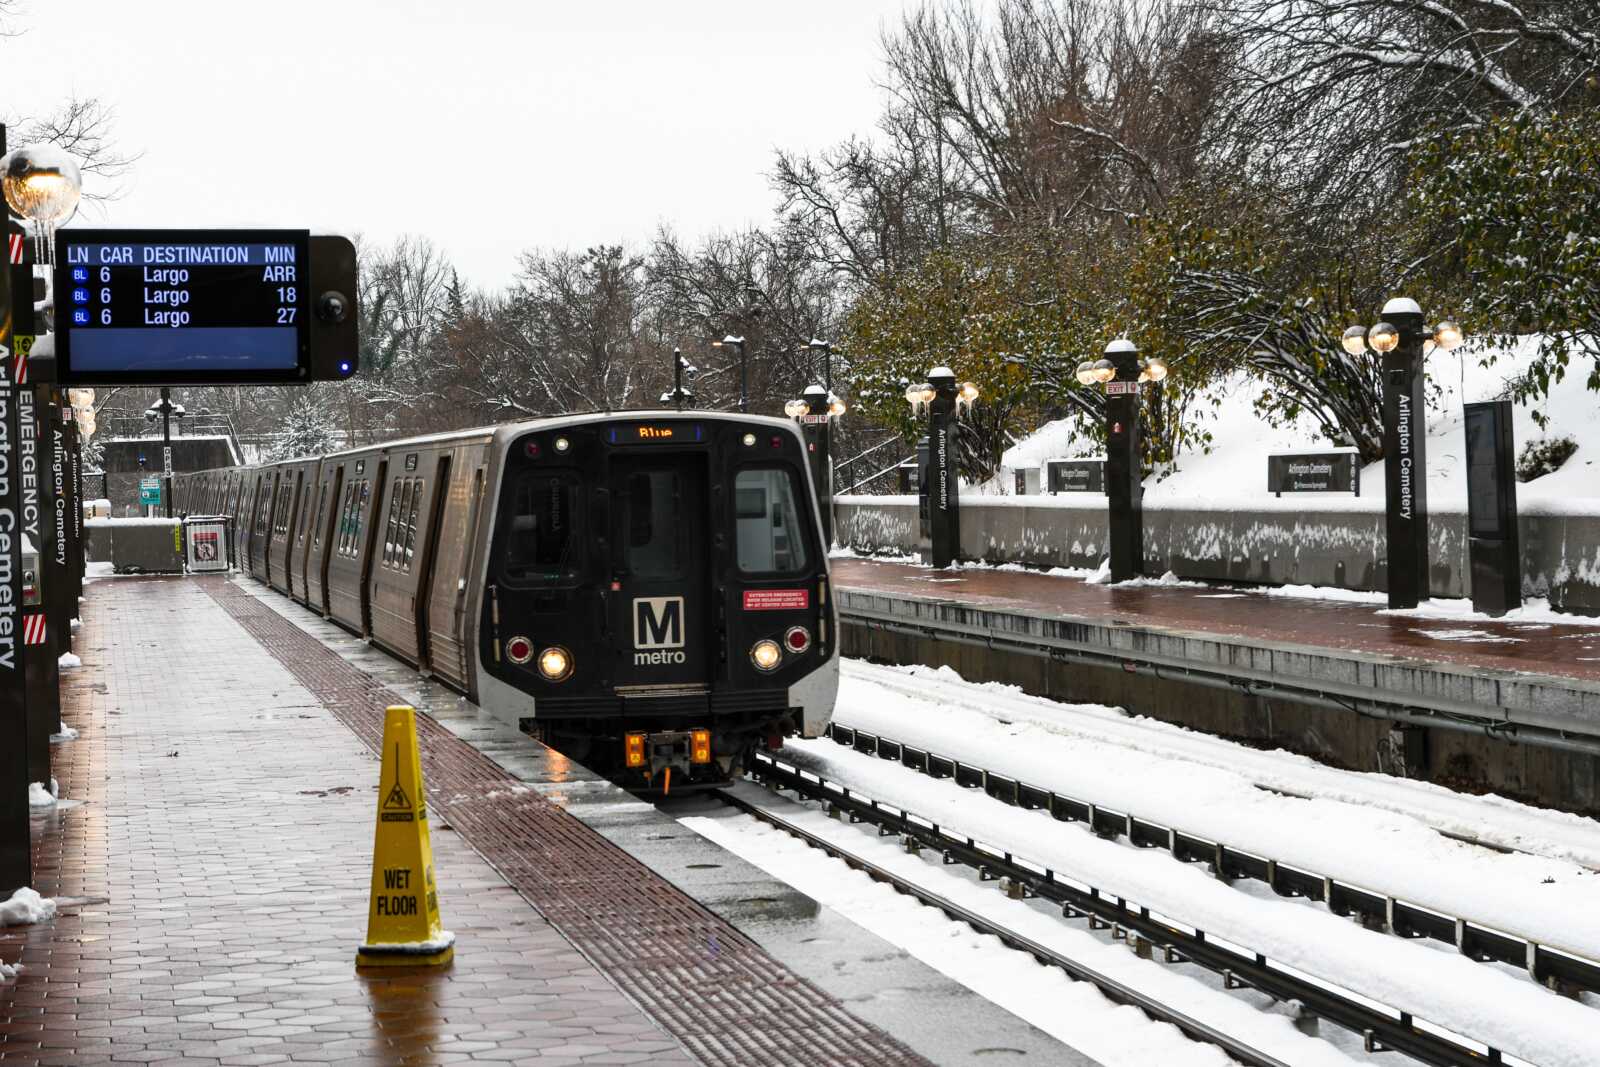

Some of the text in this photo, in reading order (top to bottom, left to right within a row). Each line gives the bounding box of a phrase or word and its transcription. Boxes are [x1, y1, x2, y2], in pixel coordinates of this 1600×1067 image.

[67, 246, 296, 263] LN CAR DESTINATION MIN
[73, 266, 297, 285] BL 6 Largo ARR
[74, 287, 297, 306] BL 6 Largo 18
[75, 308, 297, 328] BL 6 Largo 27
[19, 390, 39, 535] EMERGENCY
[1397, 394, 1412, 520] Arlington Cemetery
[937, 429, 948, 511] Arlington Cemetery
[52, 430, 66, 565] Arlington Cemetery
[637, 600, 681, 645] M
[633, 649, 686, 665] metro
[383, 869, 411, 889] WET
[377, 895, 417, 916] FLOOR
